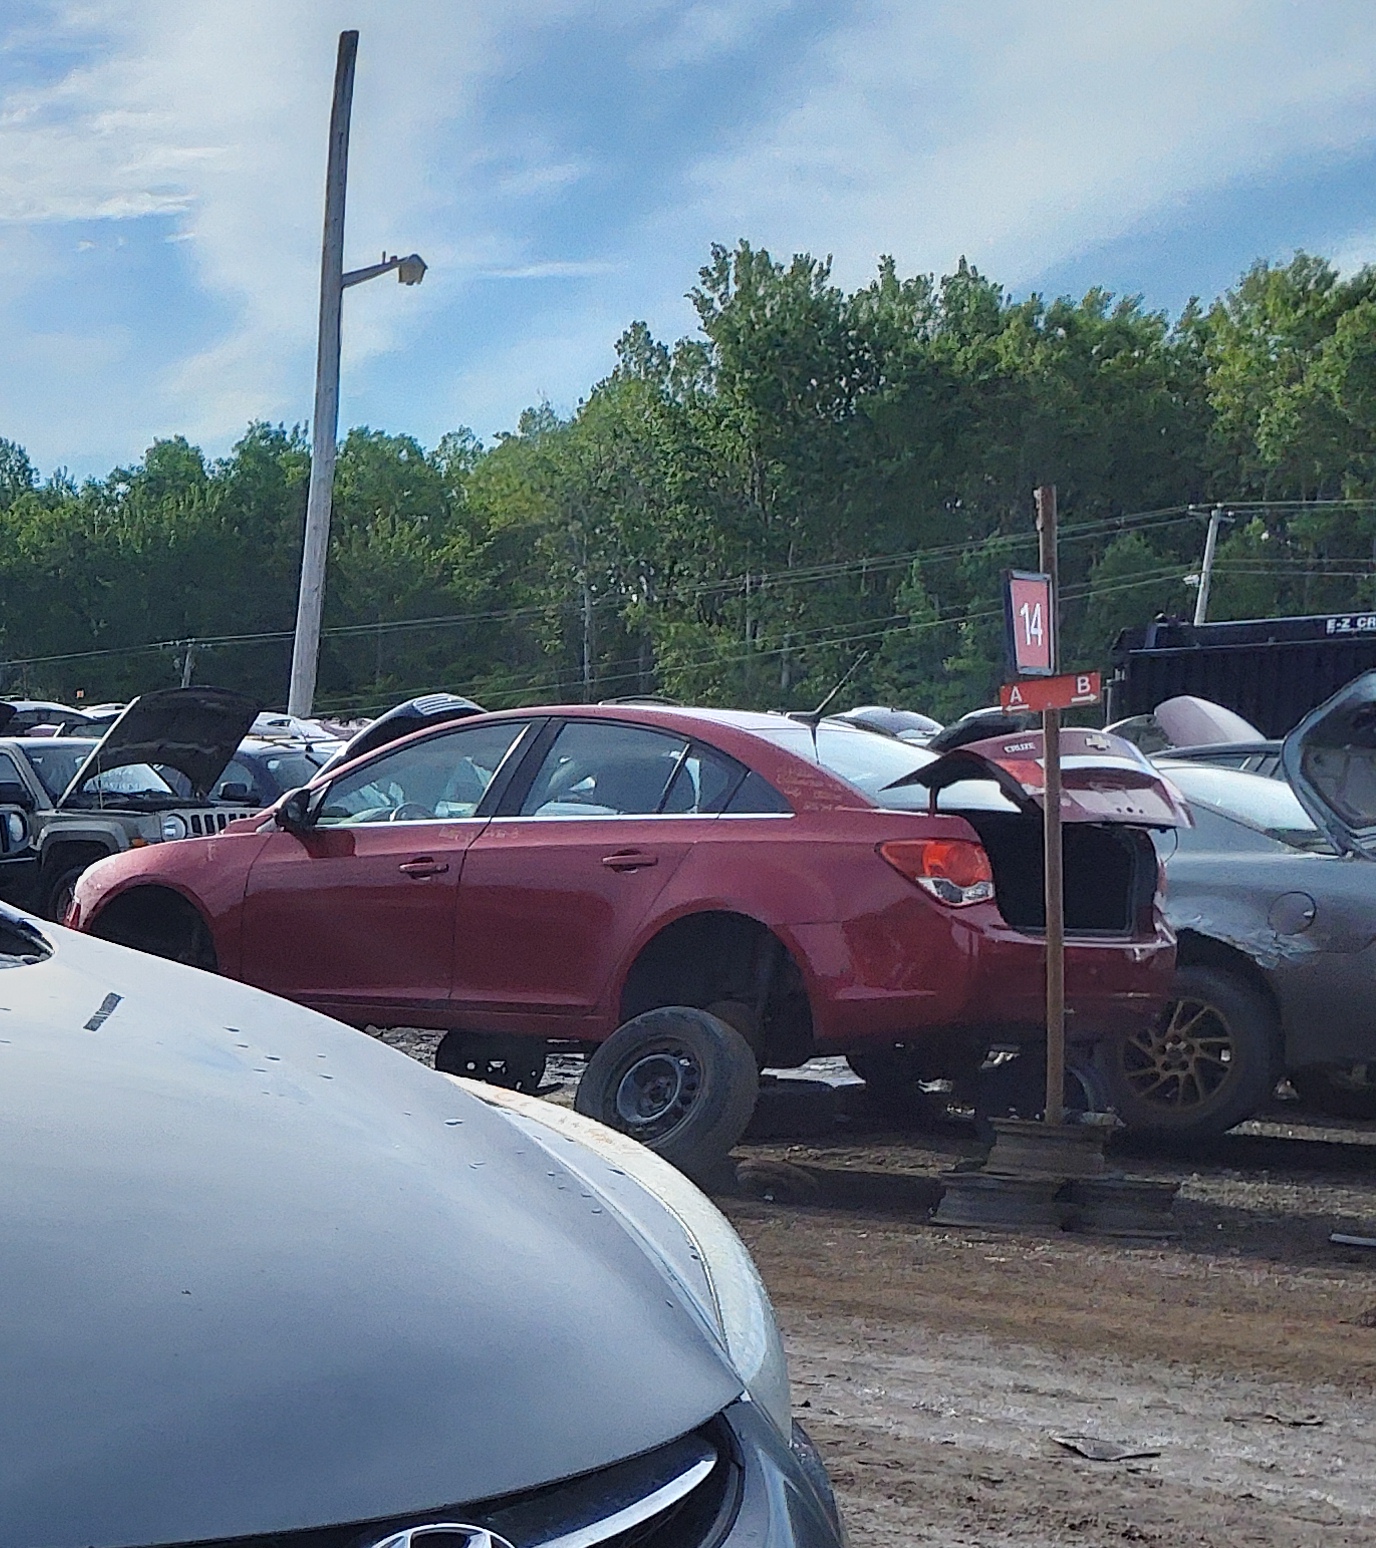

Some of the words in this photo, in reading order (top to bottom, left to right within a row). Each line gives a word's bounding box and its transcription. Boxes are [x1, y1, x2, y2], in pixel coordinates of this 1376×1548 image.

[1020, 602, 1043, 647] 14
[1326, 618, 1351, 629] E-Z
[1009, 685, 1023, 703] A
[1077, 675, 1091, 694] B
[1004, 742, 1036, 753] CRUZE
